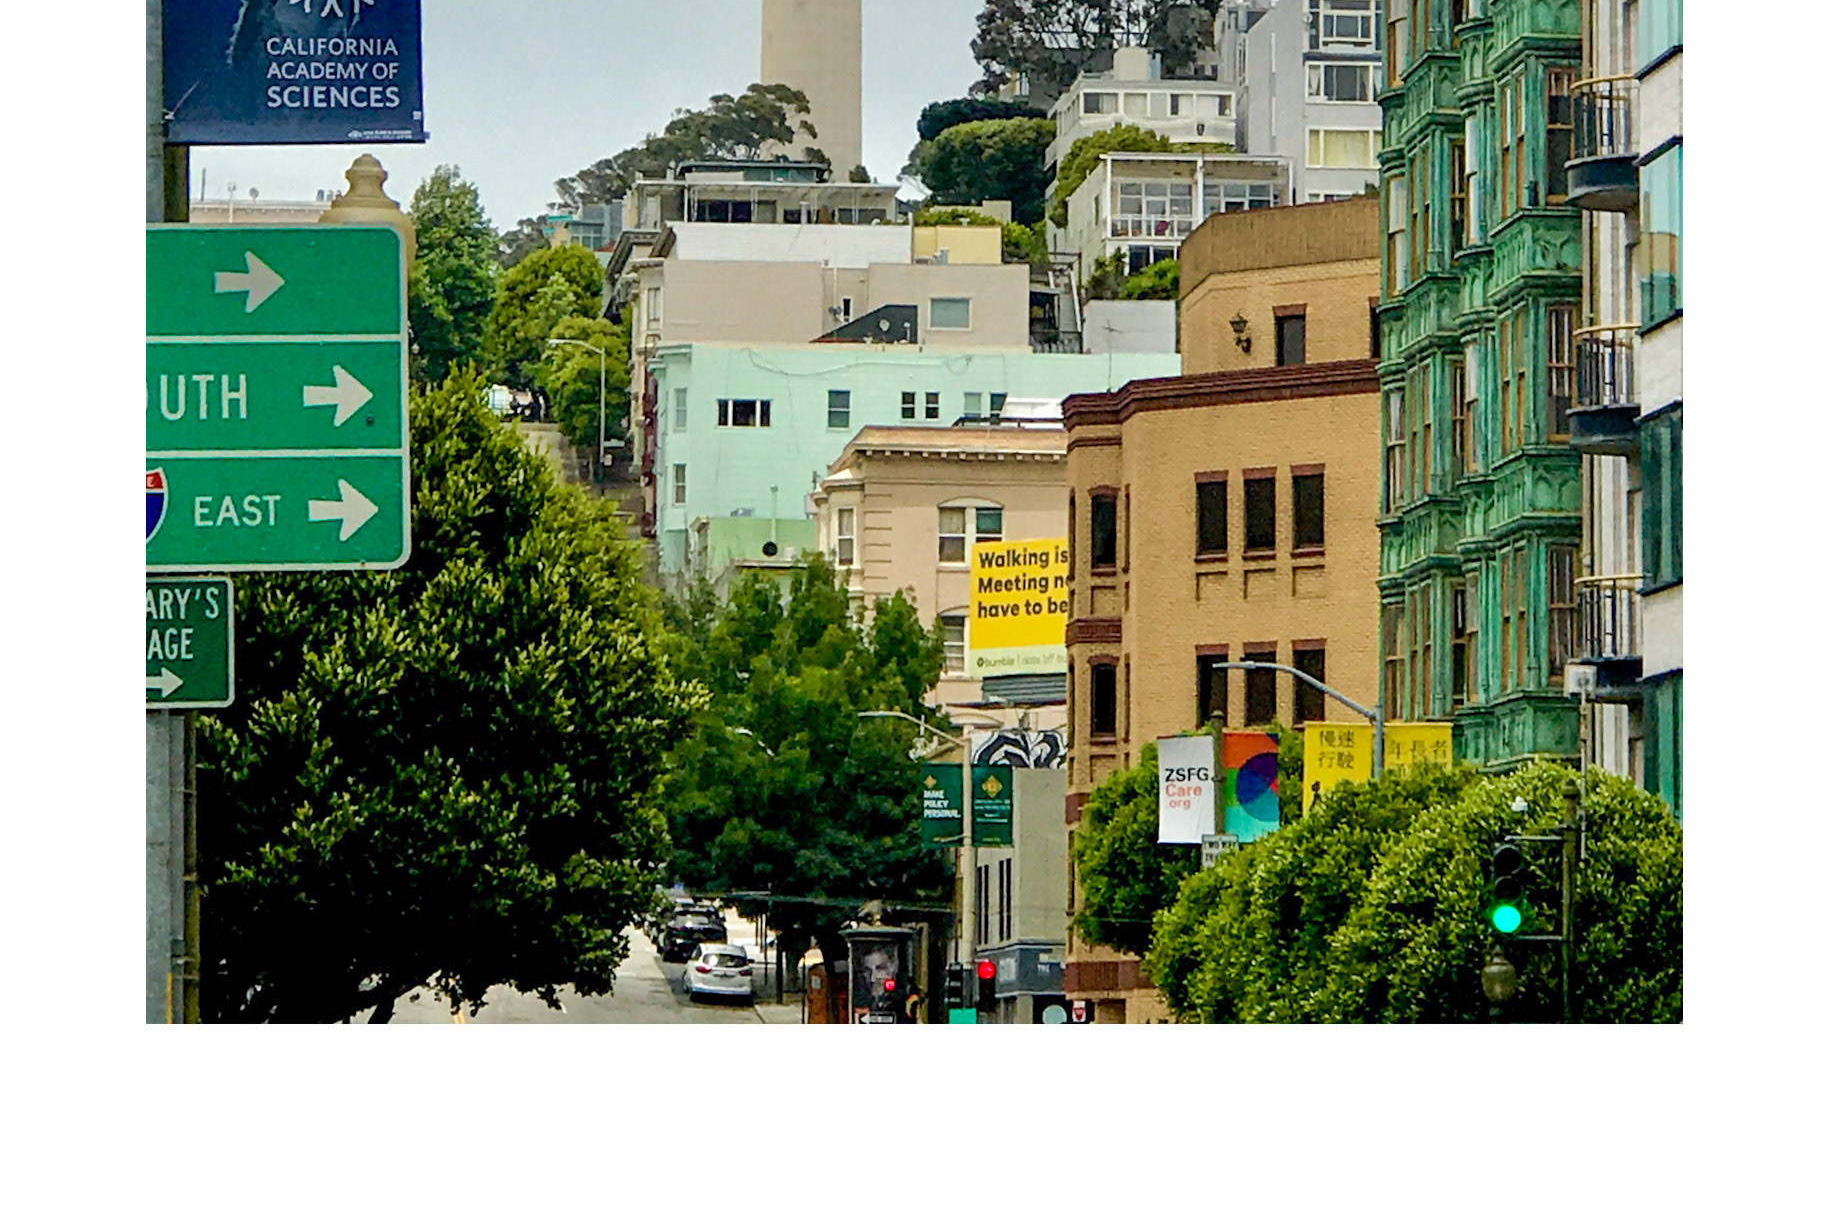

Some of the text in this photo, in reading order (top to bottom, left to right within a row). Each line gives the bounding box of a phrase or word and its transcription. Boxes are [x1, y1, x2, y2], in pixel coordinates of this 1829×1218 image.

[266, 38, 399, 56] CALIFORNIA
[266, 62, 400, 80] ACADEMY OF
[266, 86, 401, 108] SCIENCES
[146, 374, 247, 421] UTH
[194, 495, 281, 527] EAST
[979, 545, 1068, 569] Walking is
[978, 572, 1048, 594] Meeting
[978, 596, 1068, 618] have to be
[147, 627, 193, 660] AGE
[1165, 767, 1209, 782] ZSFG
[1165, 783, 1202, 797] Care
